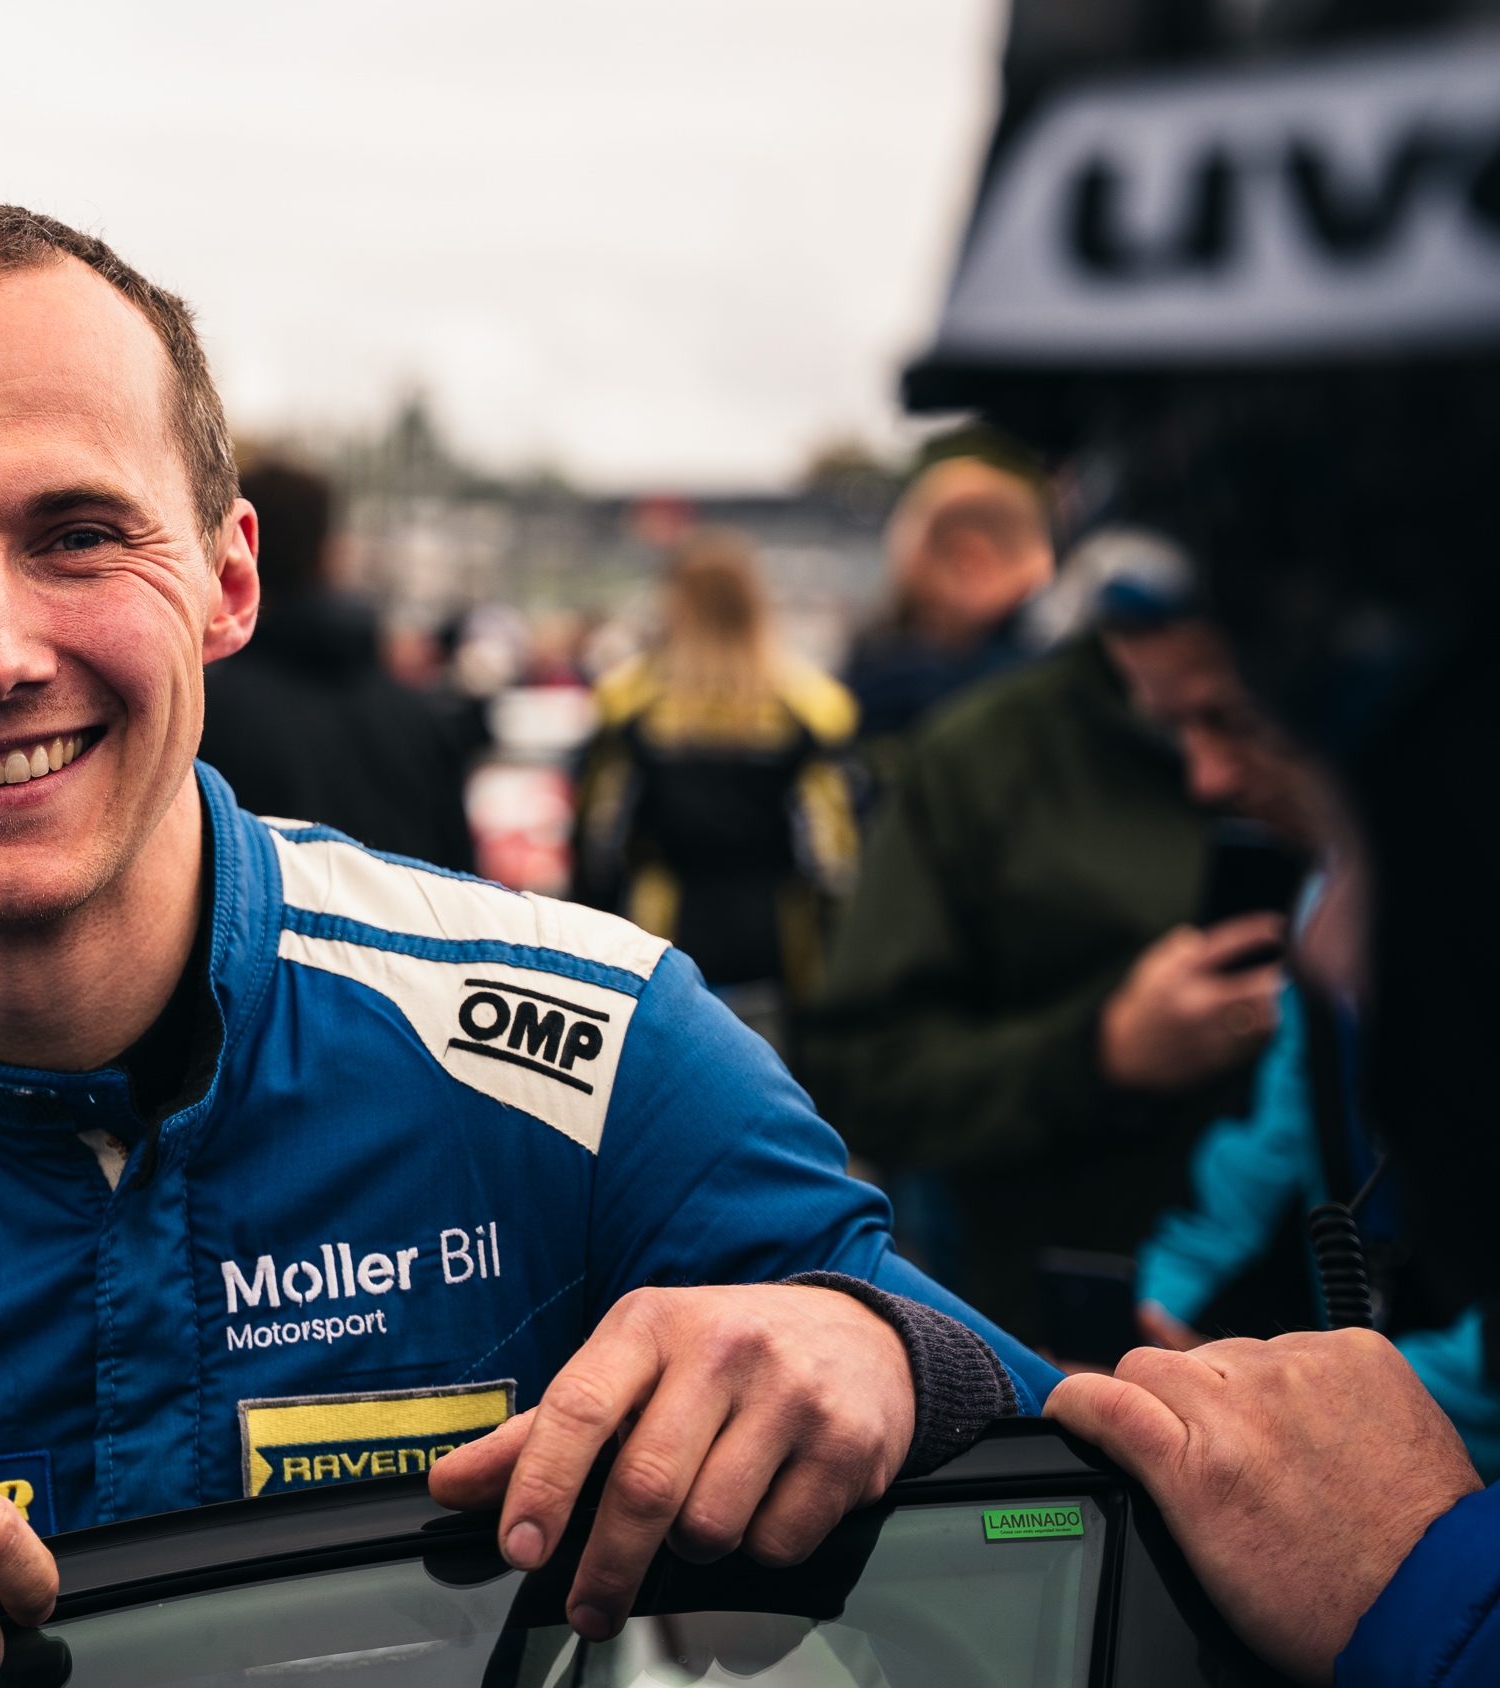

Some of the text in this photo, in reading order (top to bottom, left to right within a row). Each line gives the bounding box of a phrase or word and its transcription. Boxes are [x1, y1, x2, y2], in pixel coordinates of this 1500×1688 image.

[1065, 115, 1500, 290] uv
[458, 991, 603, 1070] OMP
[440, 1221, 501, 1284] Bil
[226, 1309, 387, 1351] Motorsport
[283, 1442, 466, 1483] RAVEN
[988, 1511, 1080, 1529] LAMINADO
